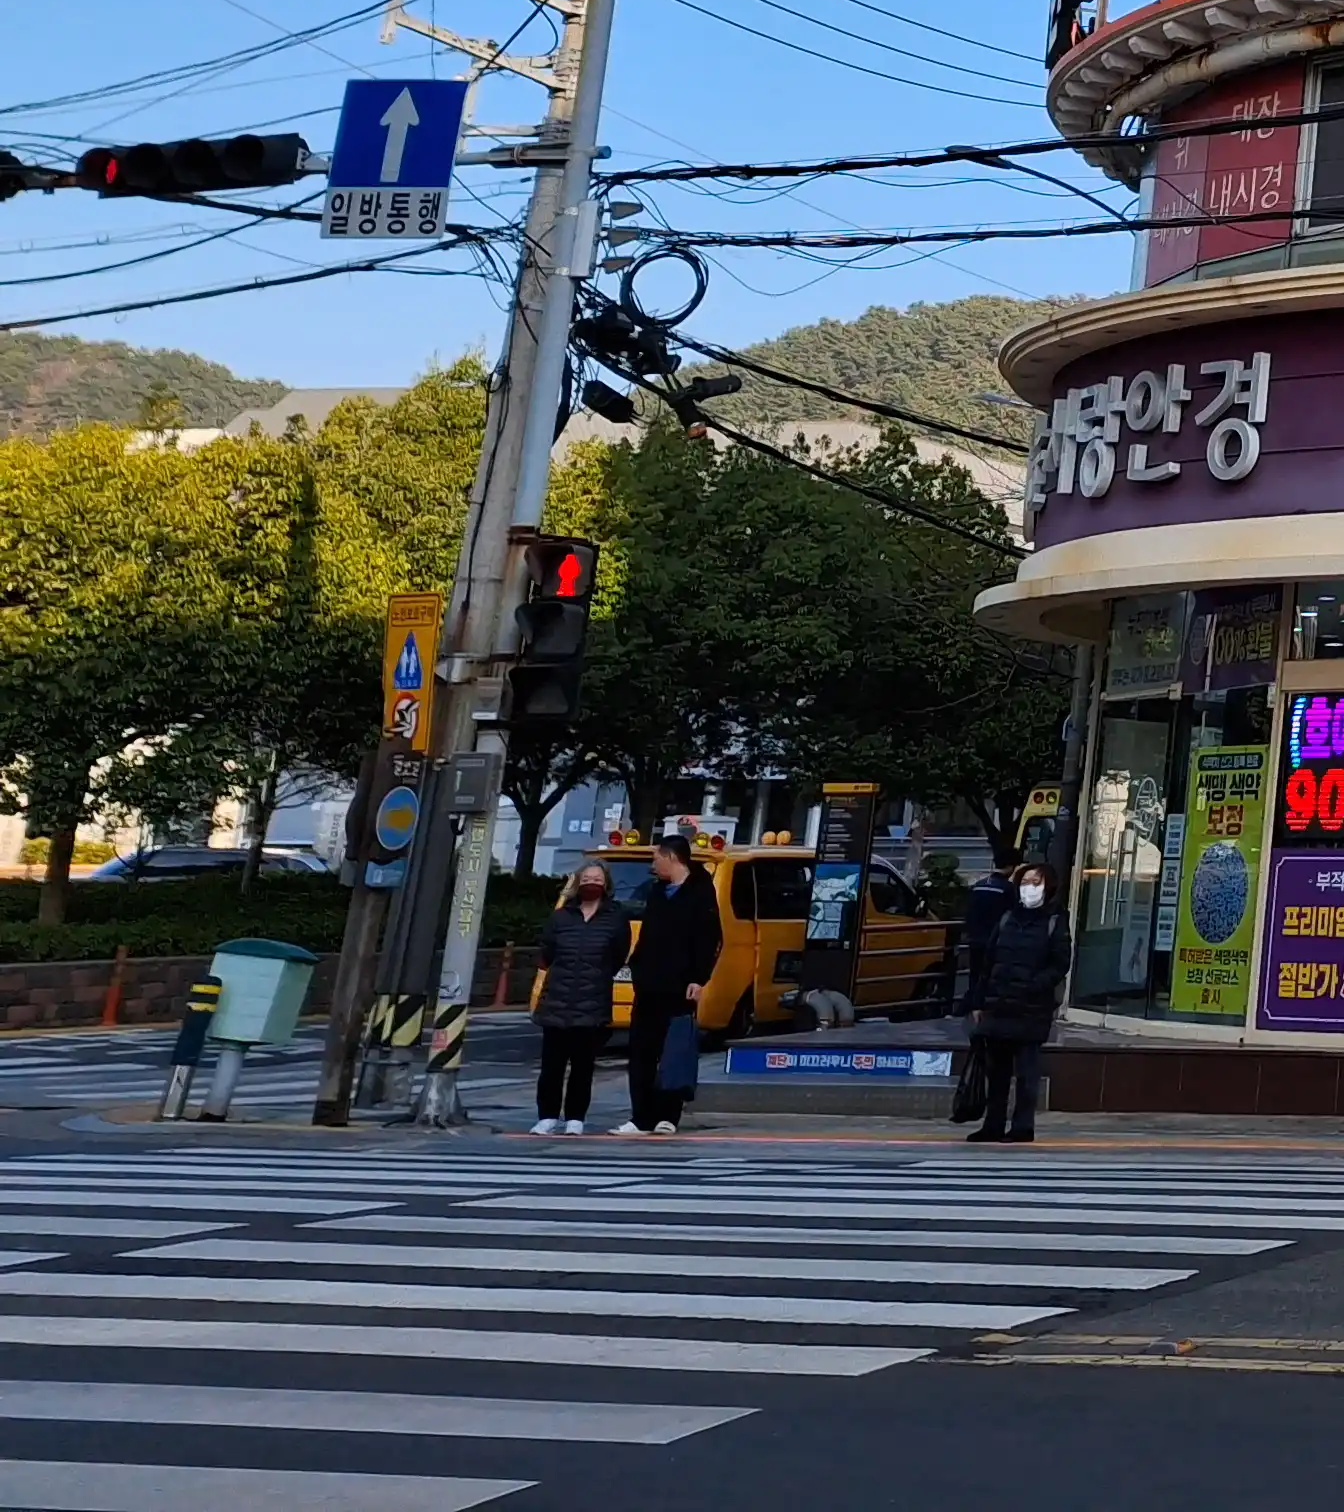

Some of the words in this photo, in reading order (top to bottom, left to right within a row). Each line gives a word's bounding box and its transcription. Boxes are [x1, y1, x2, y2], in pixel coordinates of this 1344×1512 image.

[1230, 91, 1281, 143] 대장
[1209, 162, 1283, 216] 내시경
[329, 191, 442, 235] 일방통행
[1229, 772, 1262, 801] 색약
[1206, 804, 1244, 836] 보정
[1277, 962, 1339, 1000] 절반가
